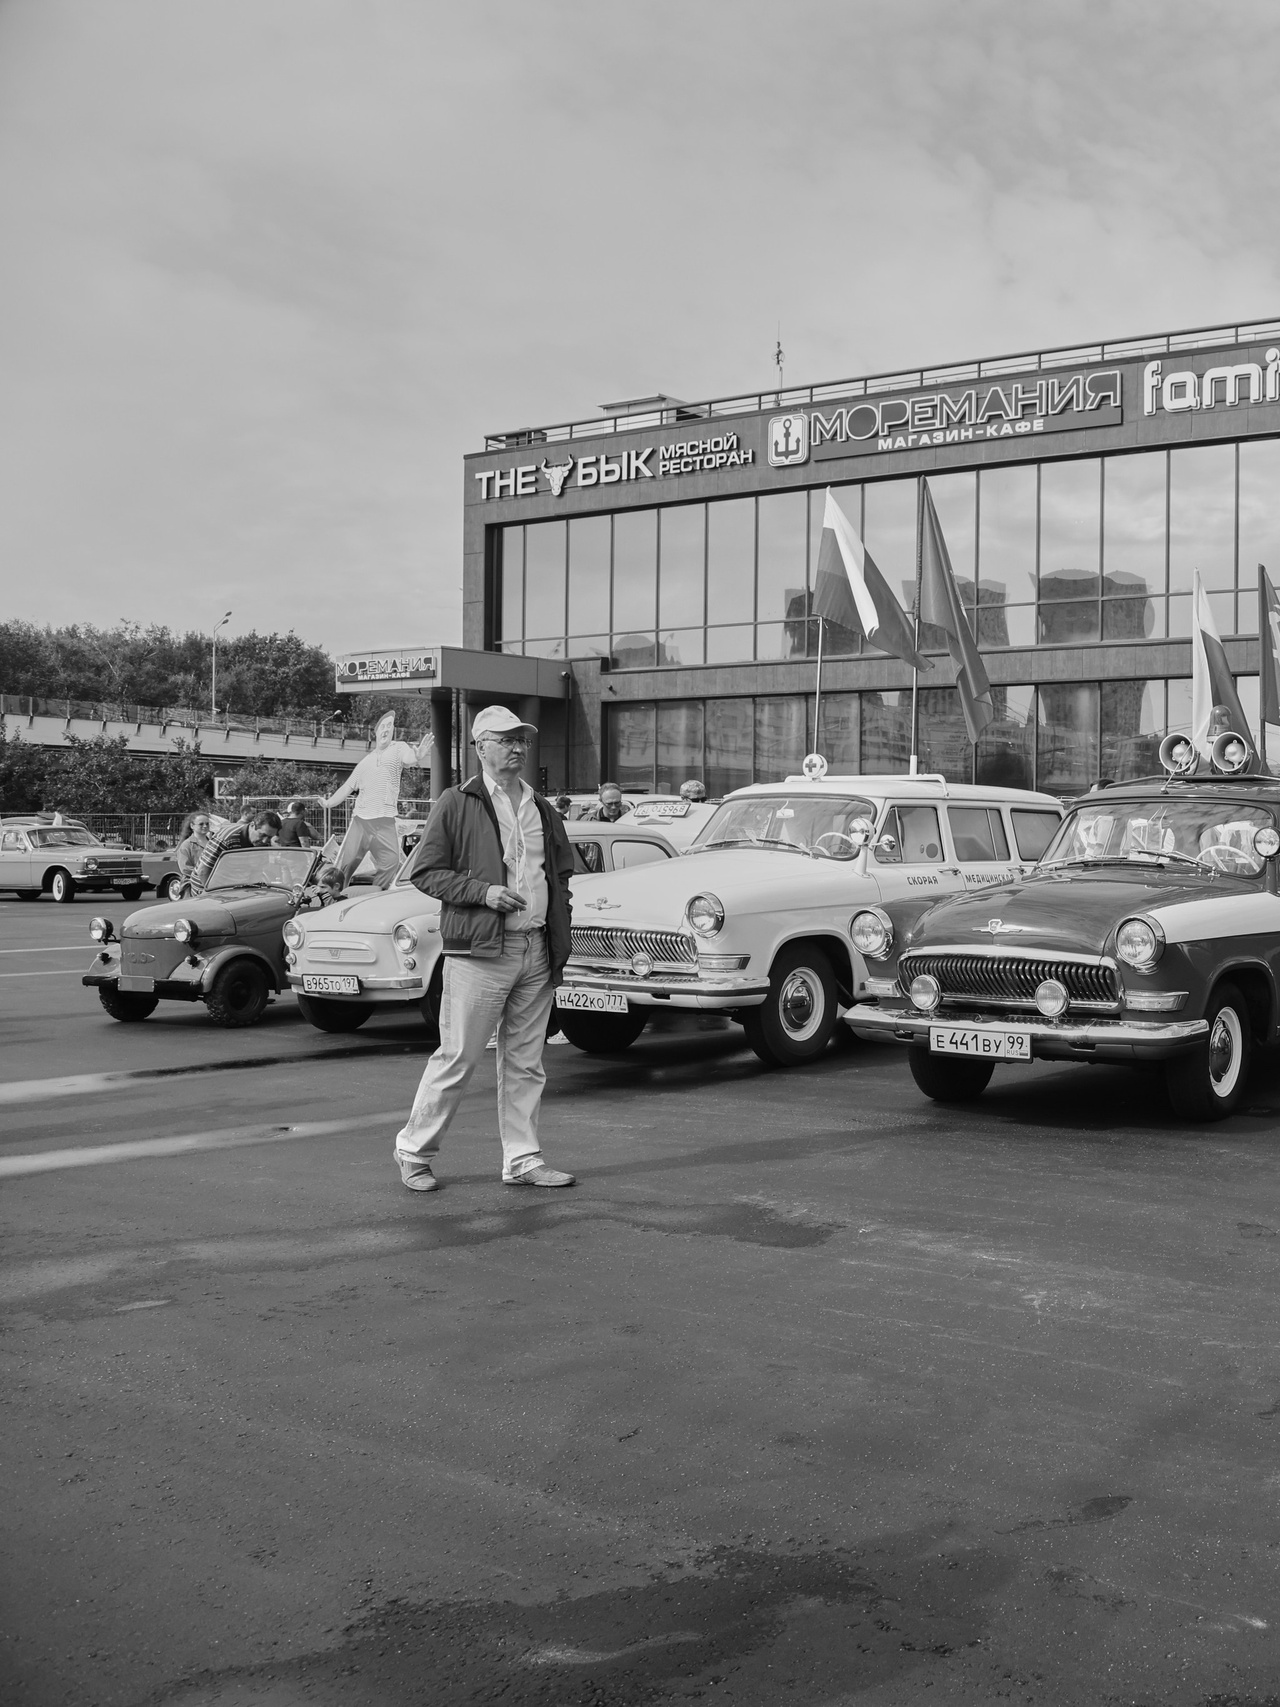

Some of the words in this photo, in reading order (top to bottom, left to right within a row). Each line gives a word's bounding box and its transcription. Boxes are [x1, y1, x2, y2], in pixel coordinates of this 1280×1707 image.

[811, 370, 1122, 445] МОРЕМАНИЯ
[659, 432, 738, 460] МЯСНОЙ
[877, 419, 1044, 450] МАГАЗИН-КАФЕ
[475, 465, 537, 499] THE
[577, 447, 655, 487] БЫК
[659, 449, 753, 475] РЕСТОРАН
[336, 656, 434, 677] МОРЕМАНИЯ
[358, 671, 410, 680] МАГАЗИН-КАФЕ
[906, 875, 939, 885] СКОРАЯ
[559, 992, 604, 1009] Н422КО
[605, 994, 623, 1006] 777
[1007, 1035, 1024, 1050] 99
